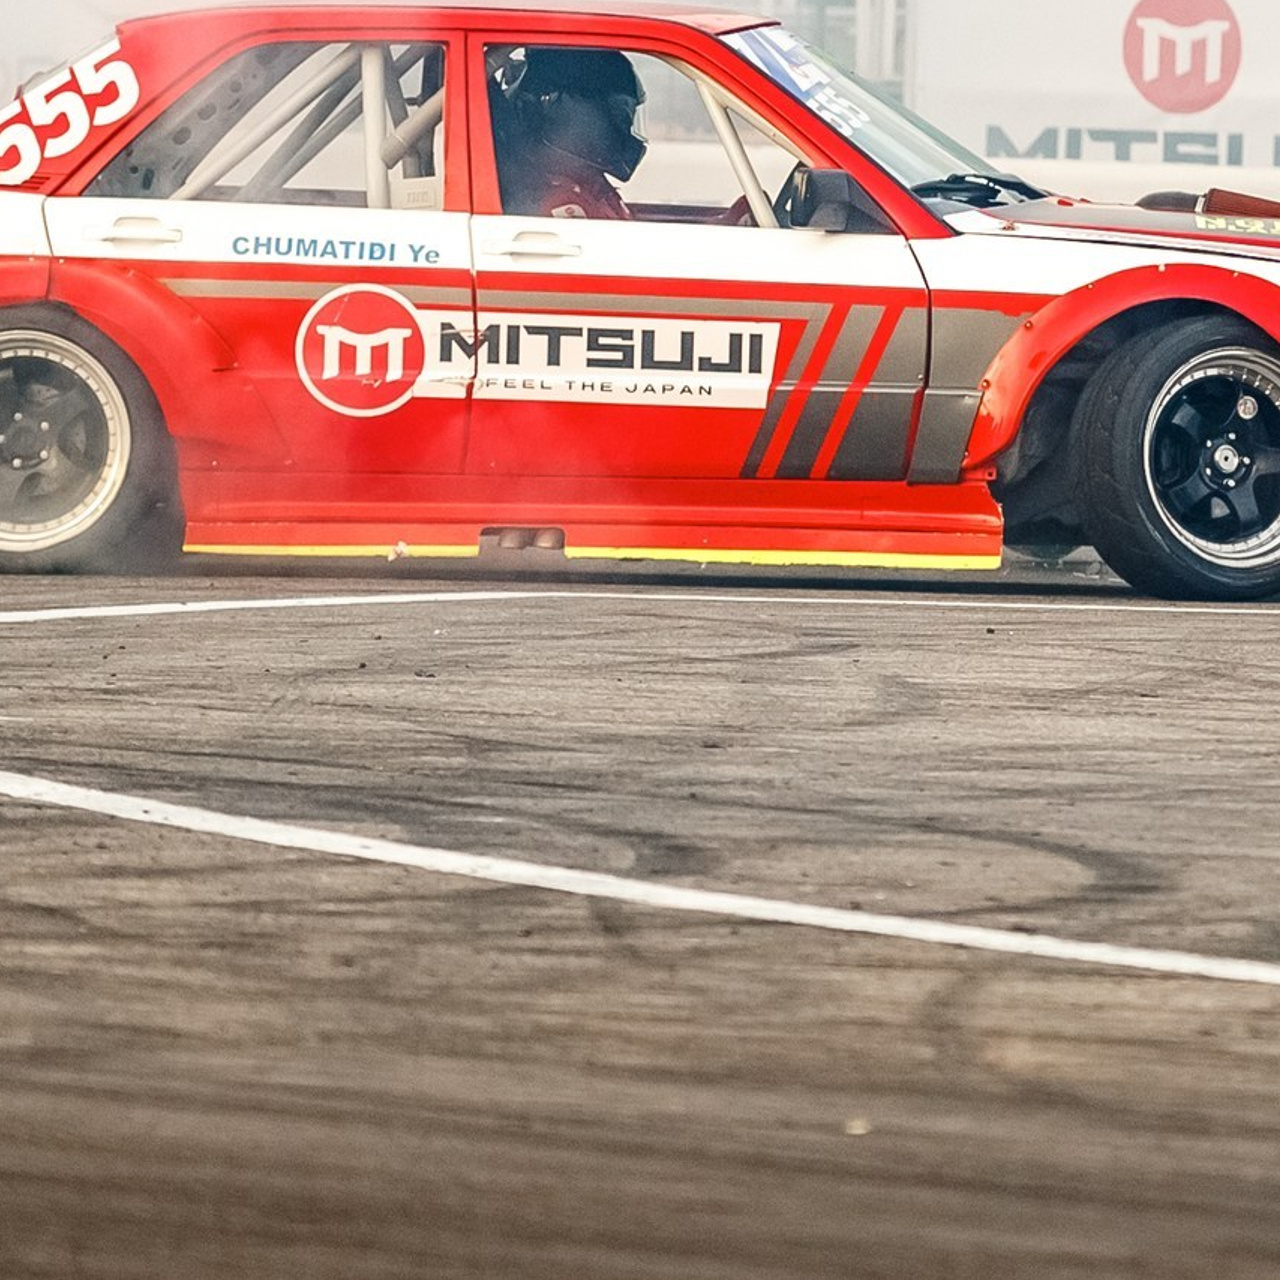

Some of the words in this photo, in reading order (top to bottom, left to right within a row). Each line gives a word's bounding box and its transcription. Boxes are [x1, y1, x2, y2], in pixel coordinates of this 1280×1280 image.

[0, 37, 141, 186] 555
[232, 236, 396, 262] CHUMATIDI
[408, 244, 440, 264] Ye
[440, 321, 763, 374] MITSUJI
[486, 378, 552, 390] FEEL
[565, 380, 613, 392] THE
[625, 384, 713, 396] JAPAN
